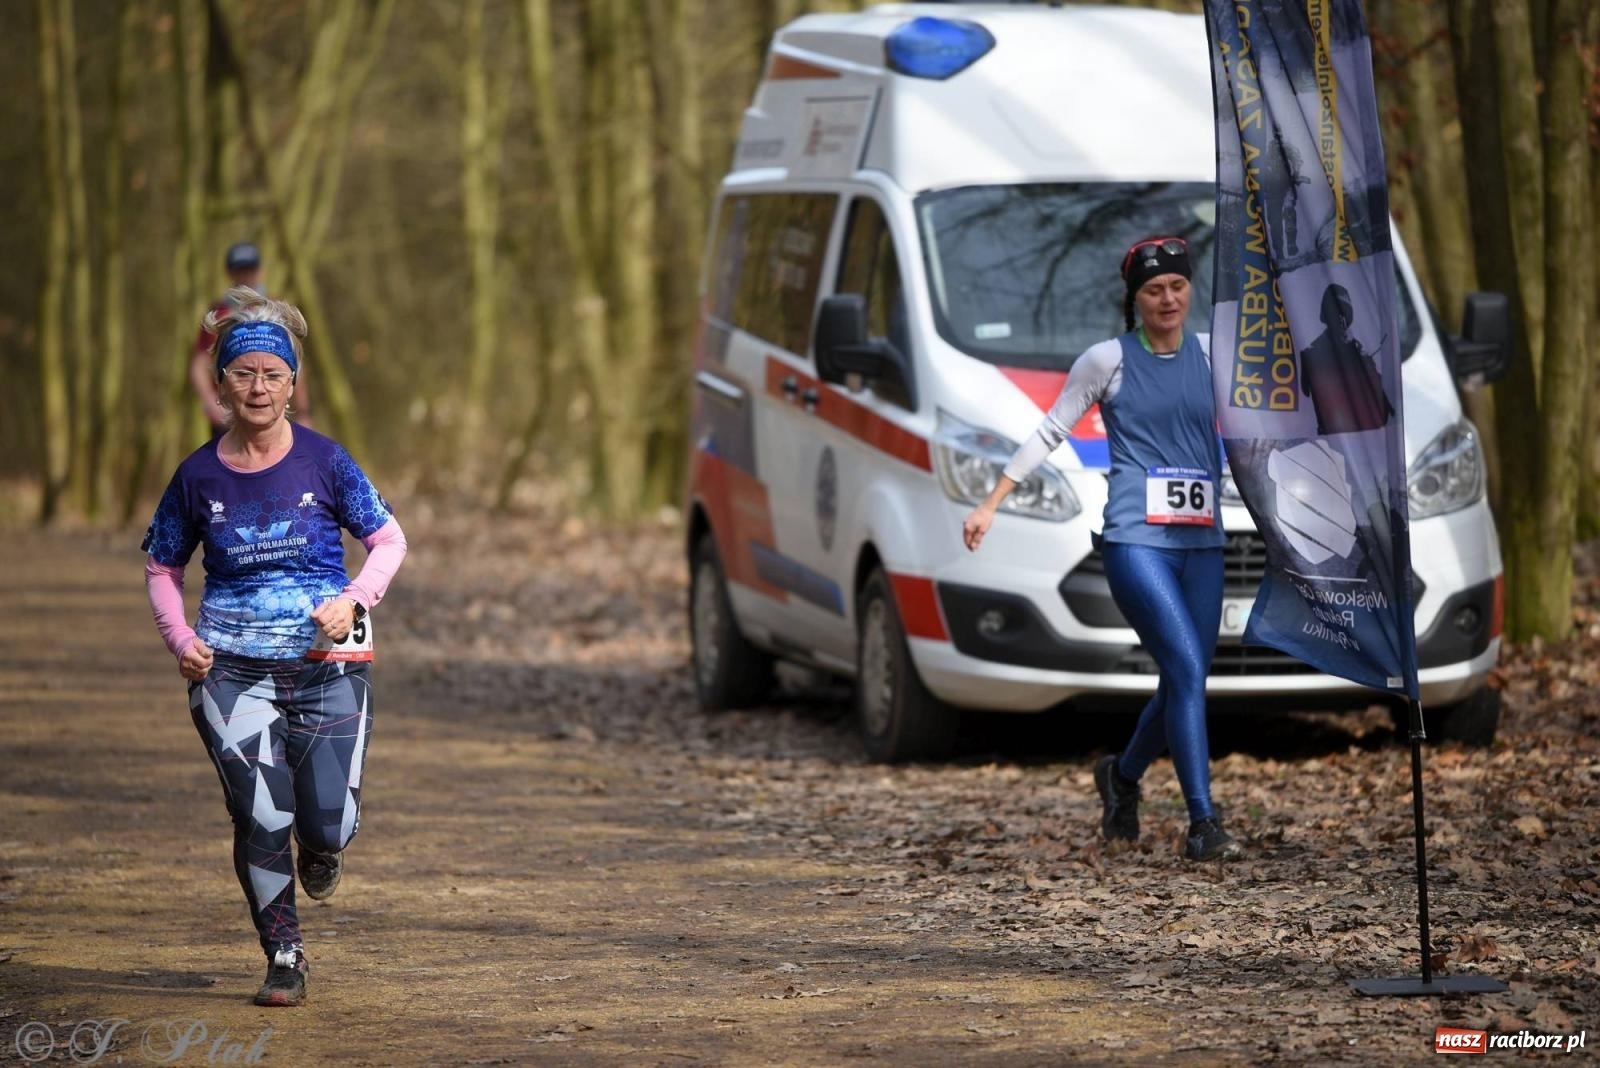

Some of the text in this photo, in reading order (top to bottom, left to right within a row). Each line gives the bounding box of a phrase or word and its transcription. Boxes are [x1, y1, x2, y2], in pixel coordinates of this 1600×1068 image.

[1167, 480, 1205, 510] 56
[226, 536, 308, 556] ZIMOWY PÓŁMARATON
[255, 549, 299, 562] STOŁOWYCH
